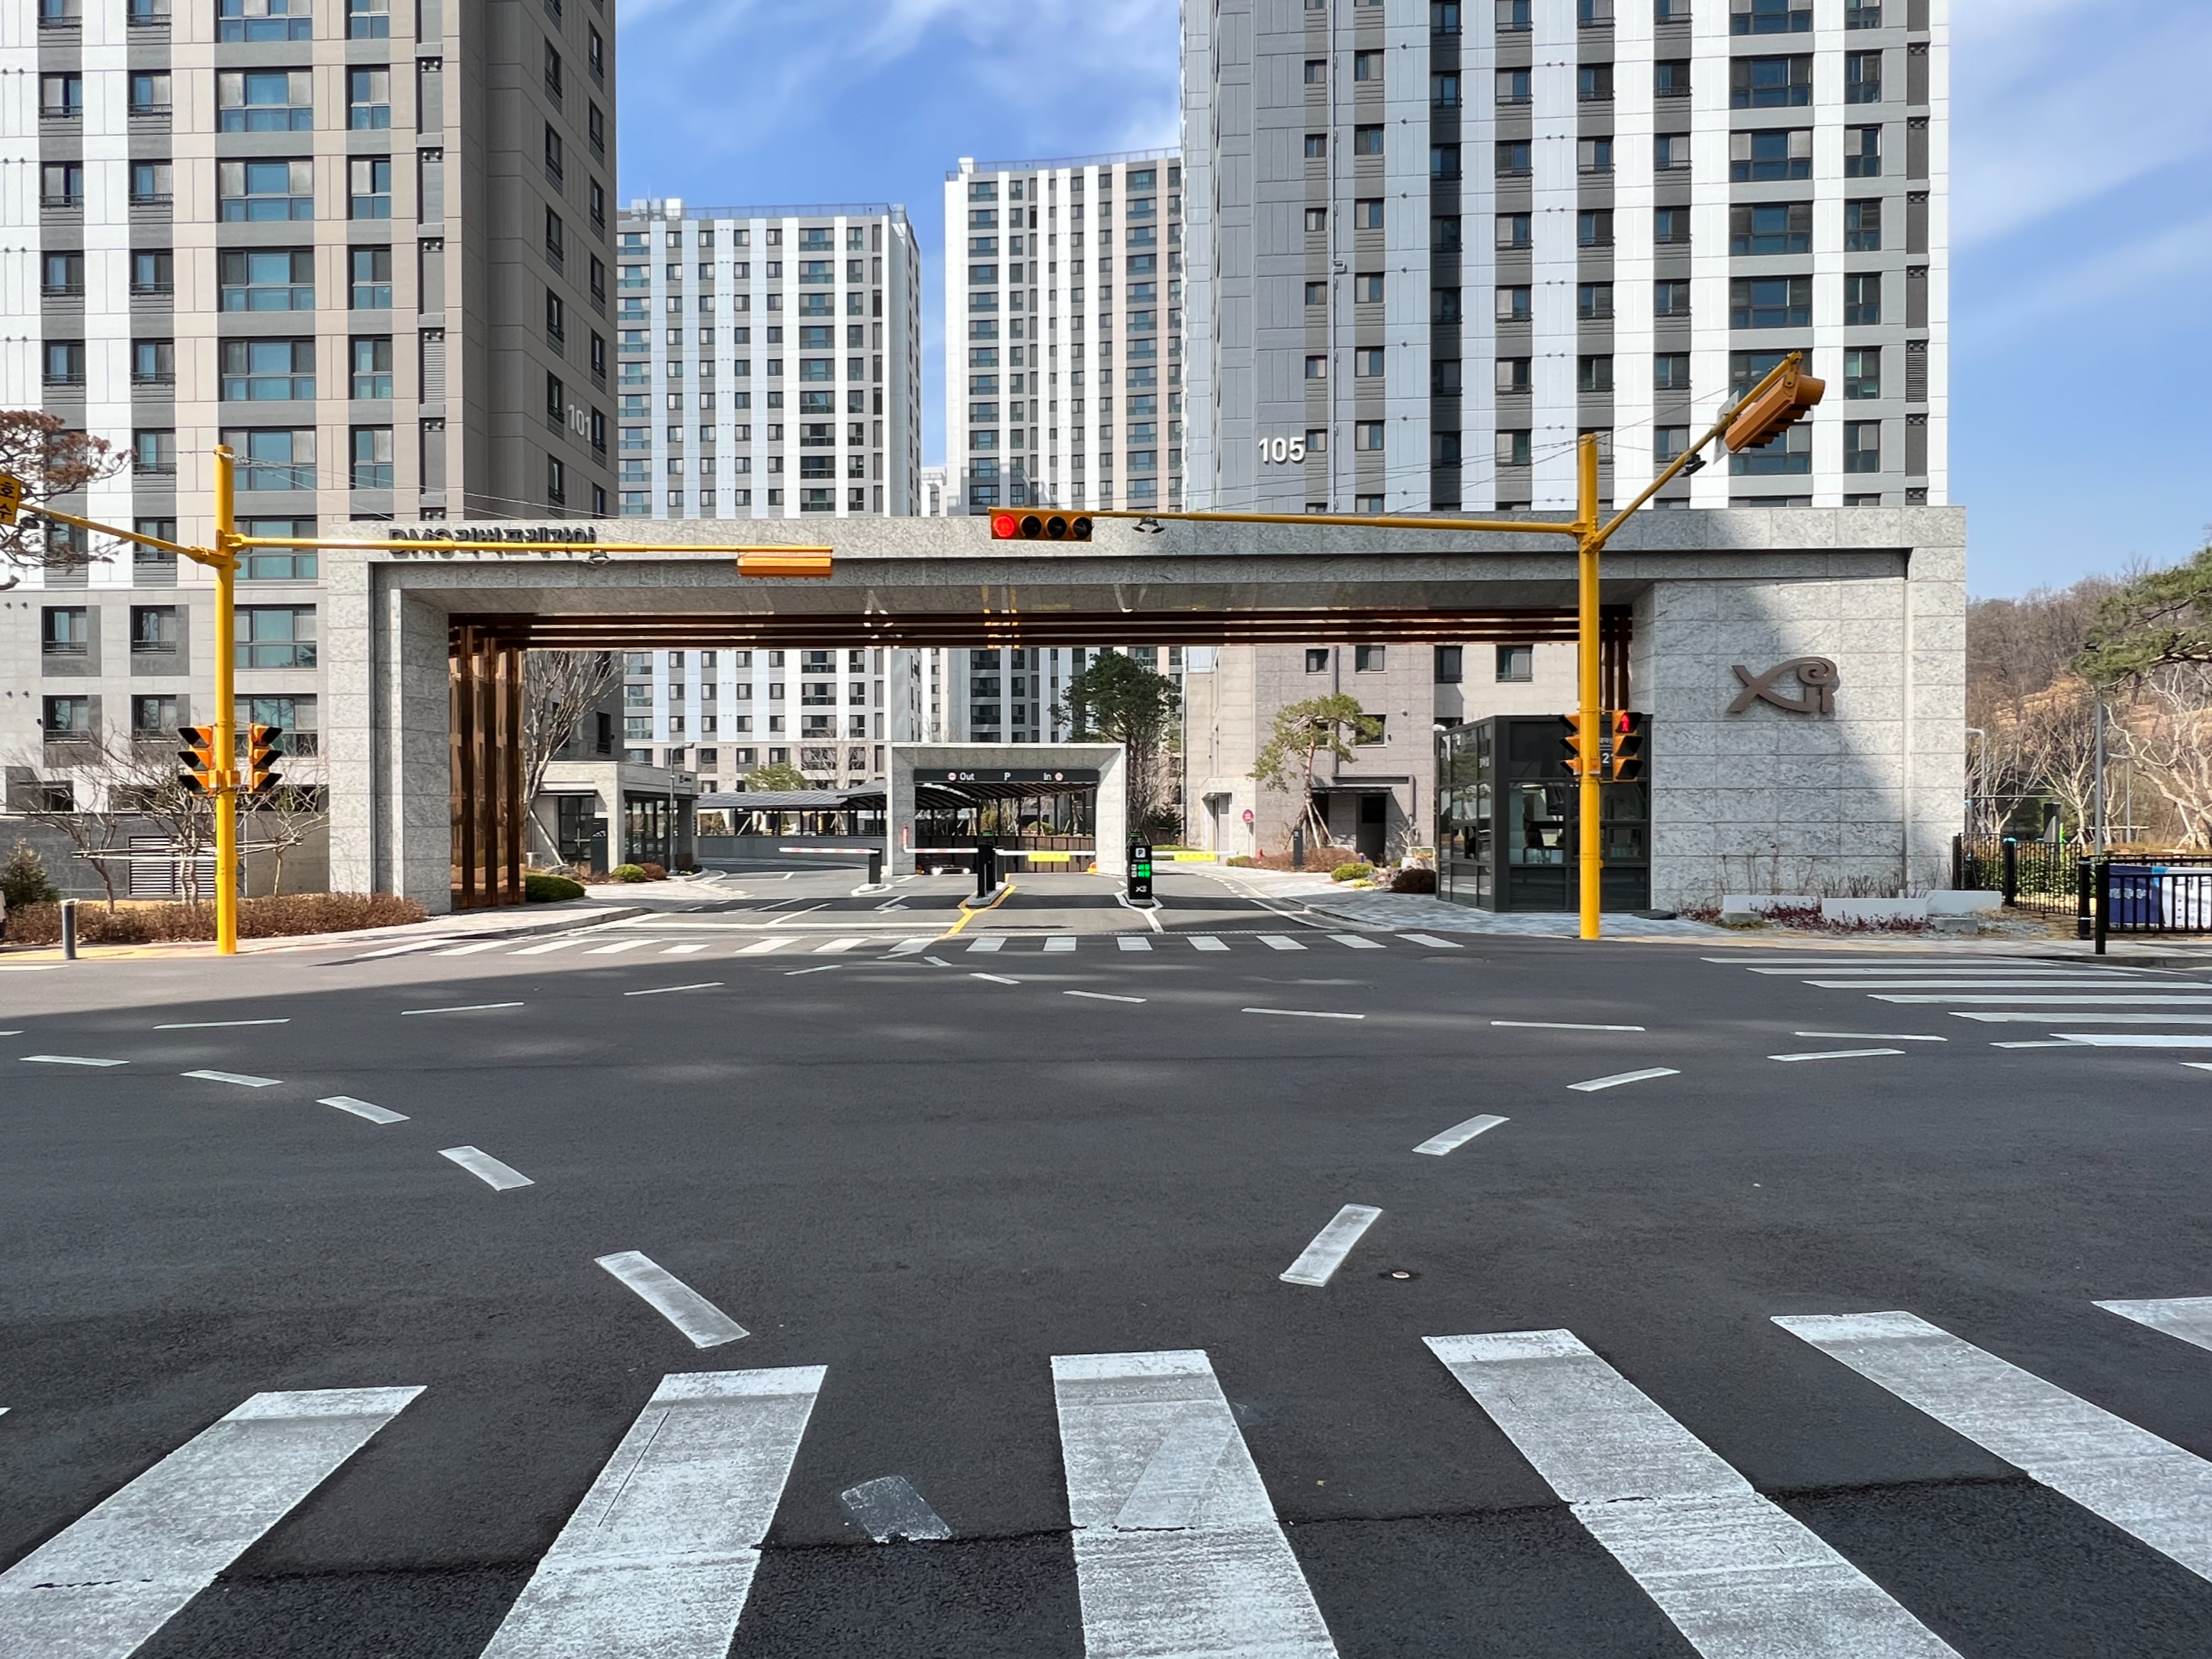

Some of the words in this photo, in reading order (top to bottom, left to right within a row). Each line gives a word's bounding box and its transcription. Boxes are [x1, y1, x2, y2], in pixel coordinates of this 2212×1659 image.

[567, 404, 592, 441] 101
[1258, 437, 1305, 462] 105
[959, 772, 975, 781] Out
[1003, 772, 1011, 781] P
[1043, 772, 1052, 781] In
